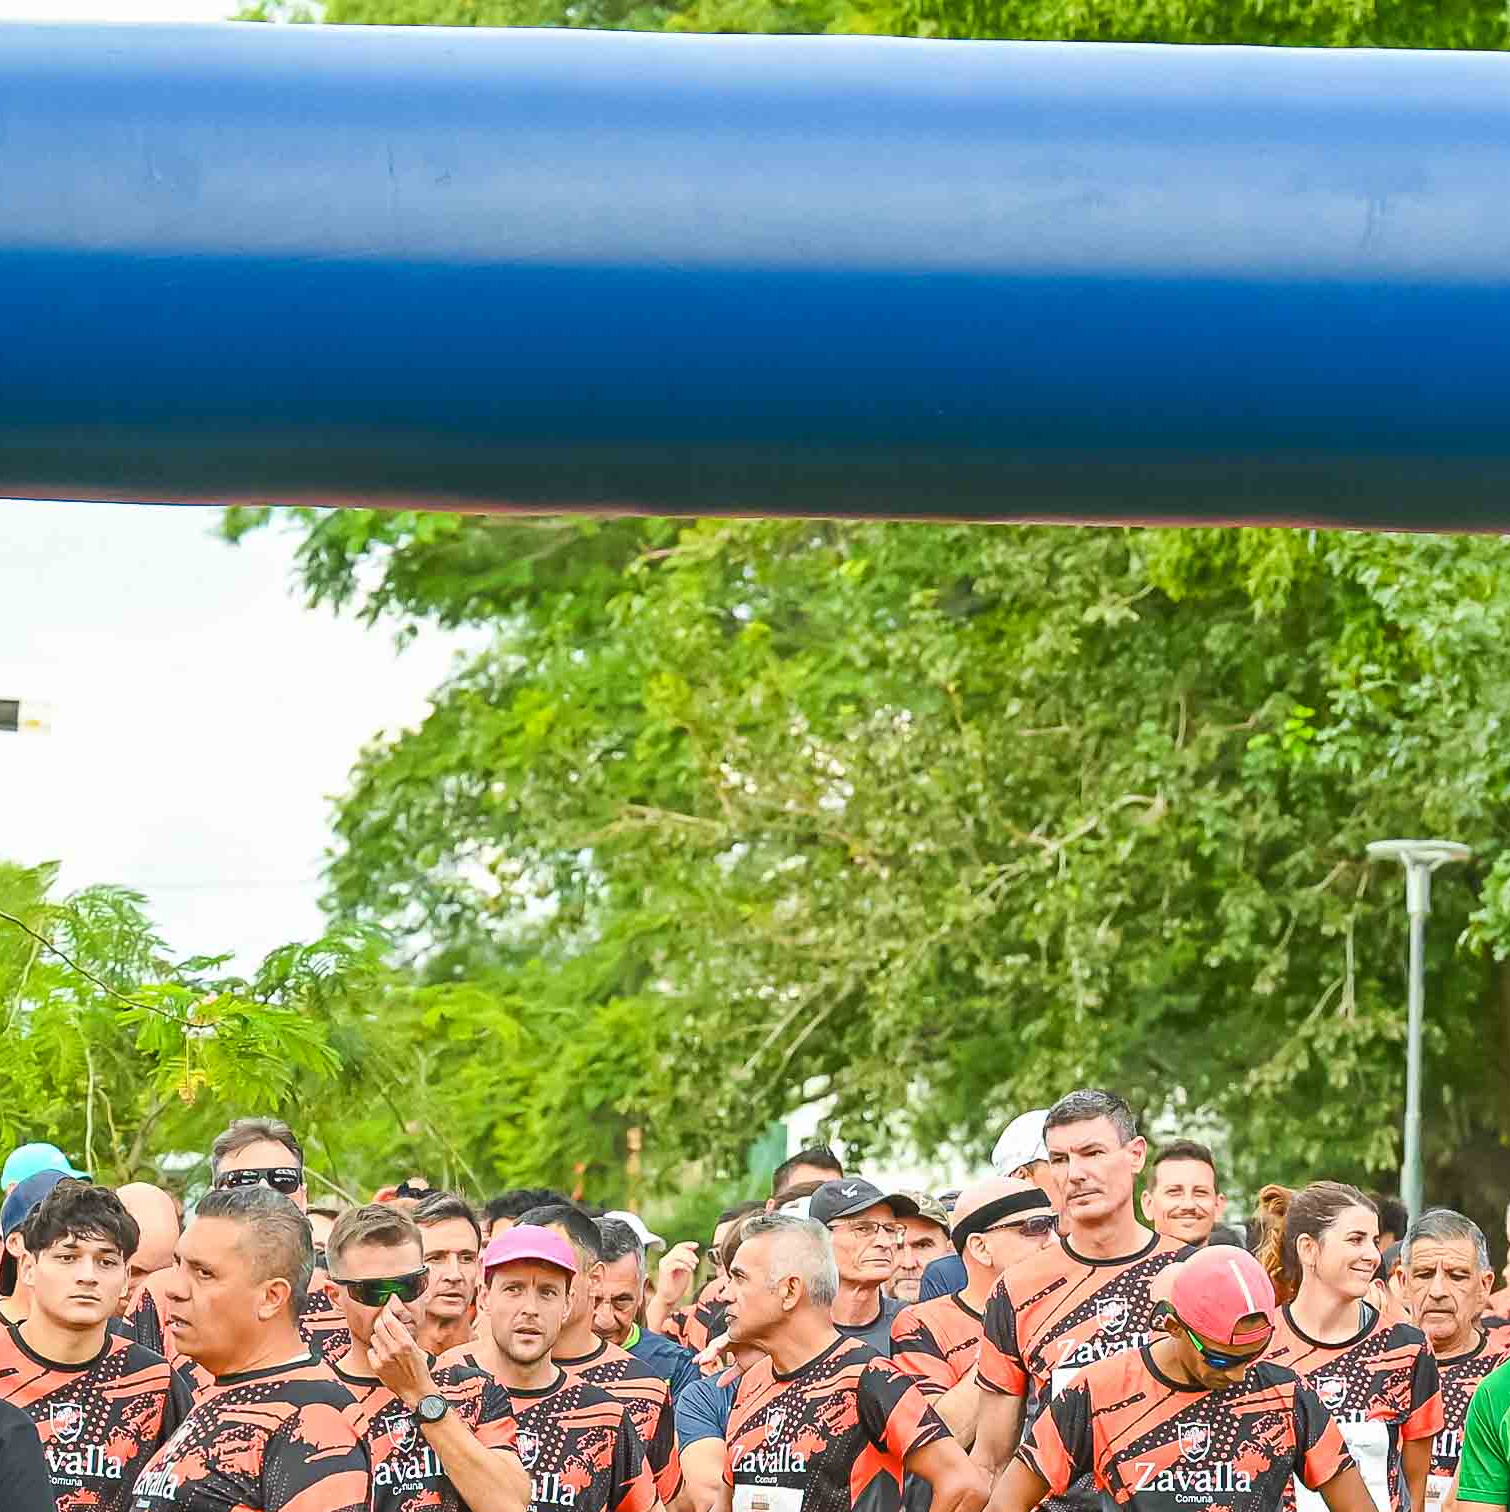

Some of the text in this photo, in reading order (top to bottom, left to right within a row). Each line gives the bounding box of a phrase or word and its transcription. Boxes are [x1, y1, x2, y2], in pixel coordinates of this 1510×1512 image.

[46, 1444, 122, 1479] valla
[374, 1446, 442, 1486] avall
[731, 1442, 807, 1474] Zavalla
[49, 1475, 83, 1487] omuna
[1134, 1461, 1252, 1493] Zavalla
[1175, 1493, 1214, 1504] Comuna
